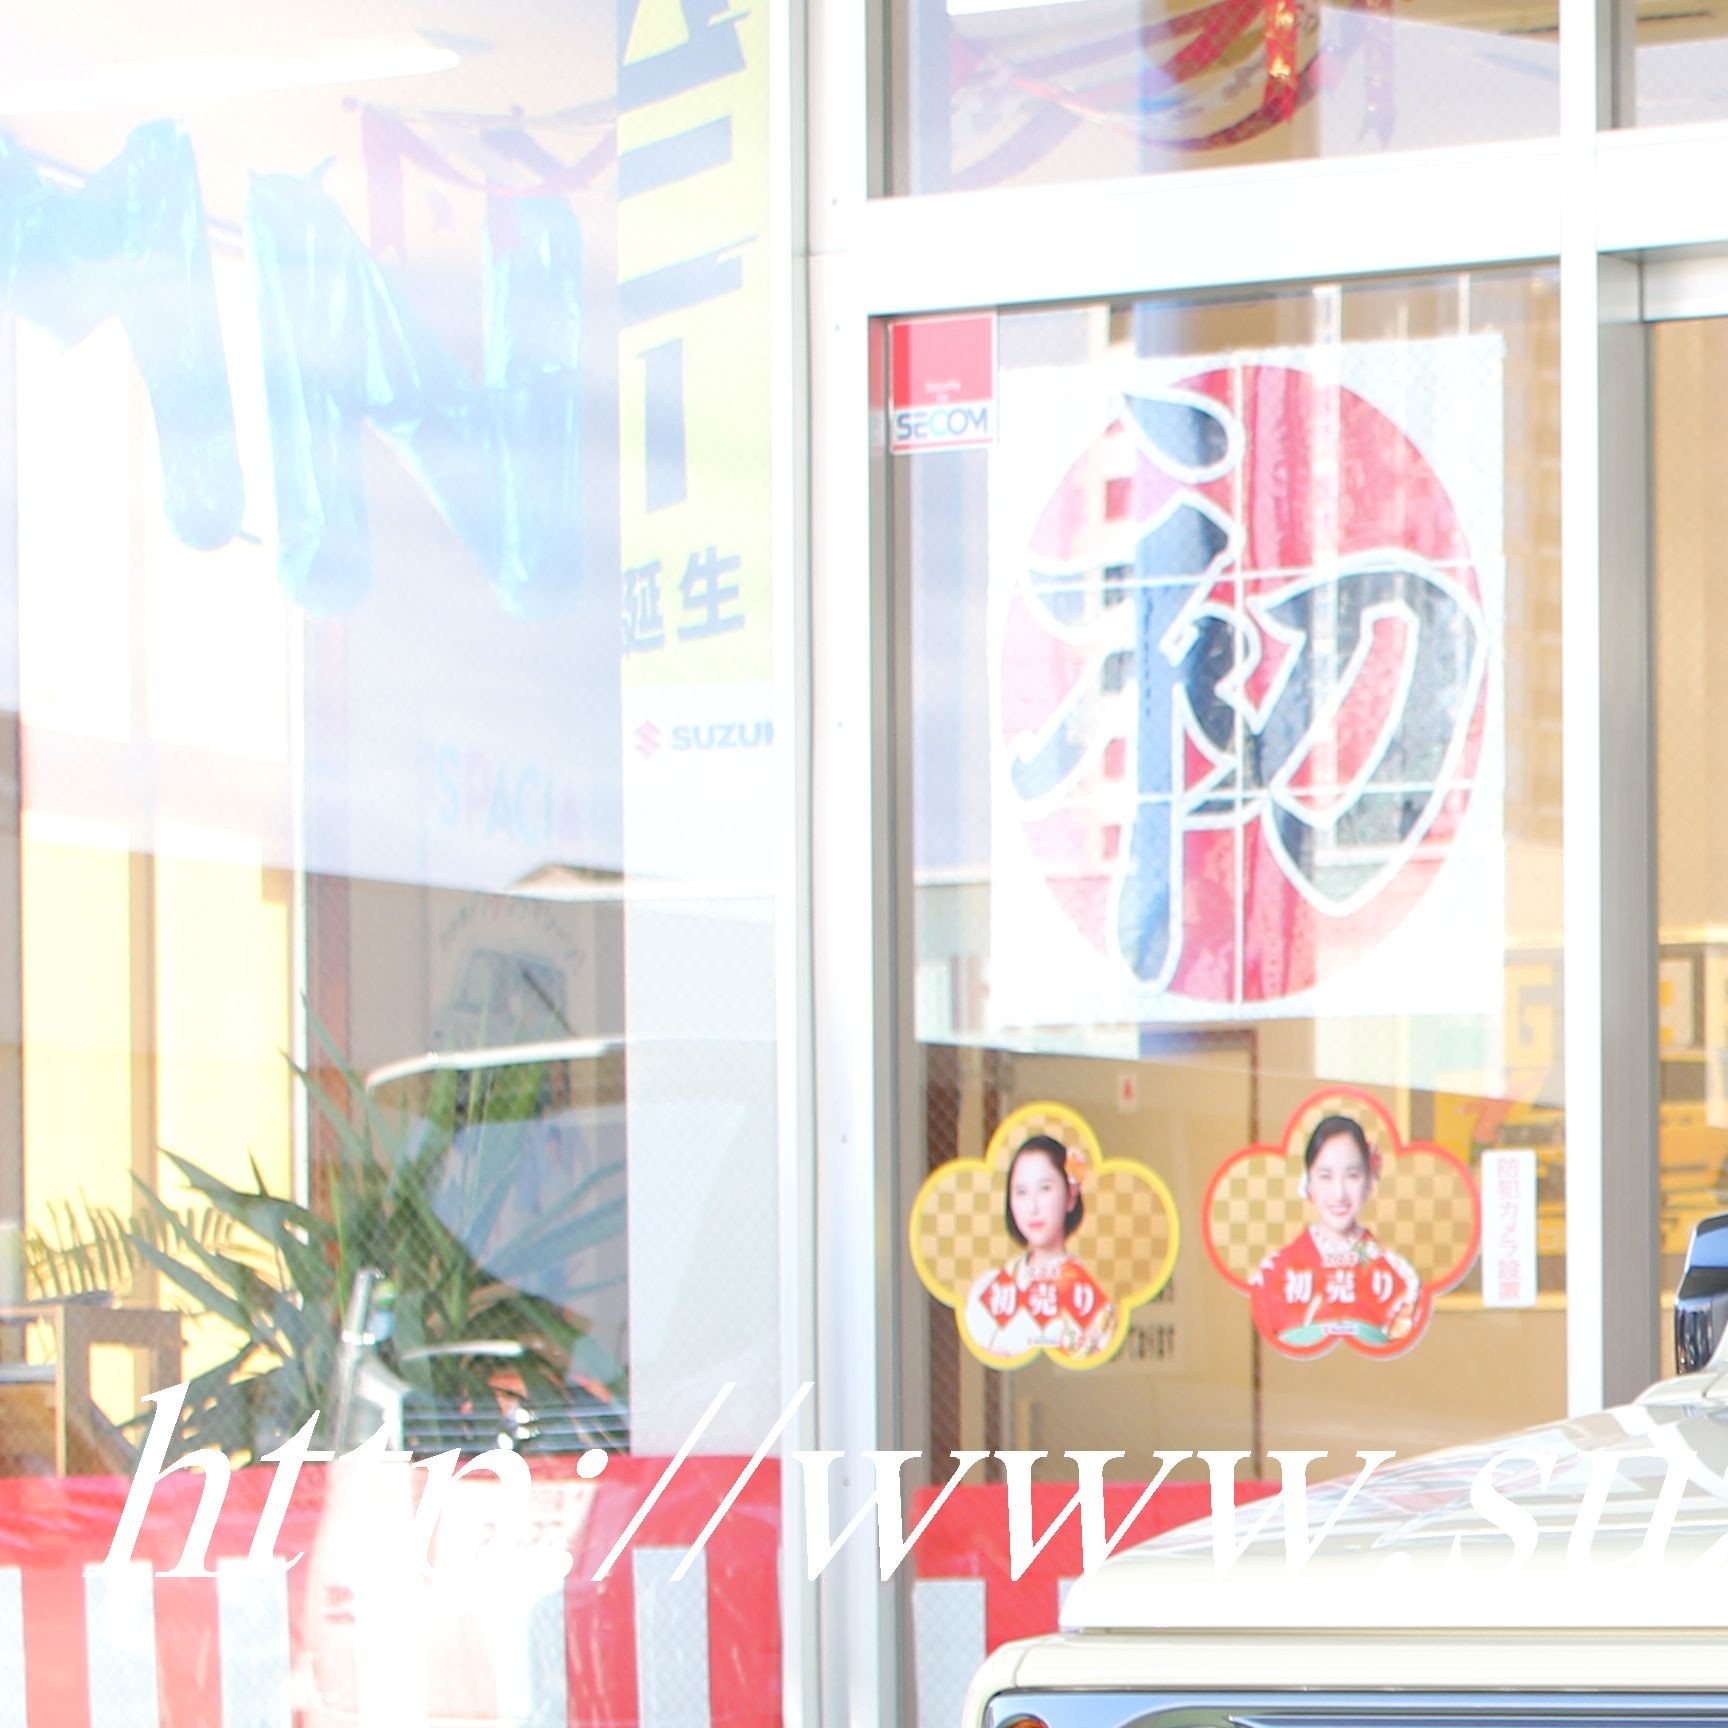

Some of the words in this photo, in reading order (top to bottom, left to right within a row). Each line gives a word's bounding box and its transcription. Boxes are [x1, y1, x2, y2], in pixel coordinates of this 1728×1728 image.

[896, 407, 989, 441] SECOM
[990, 1282, 1096, 1317] 初売り
[1284, 1268, 1394, 1304] 初売り
